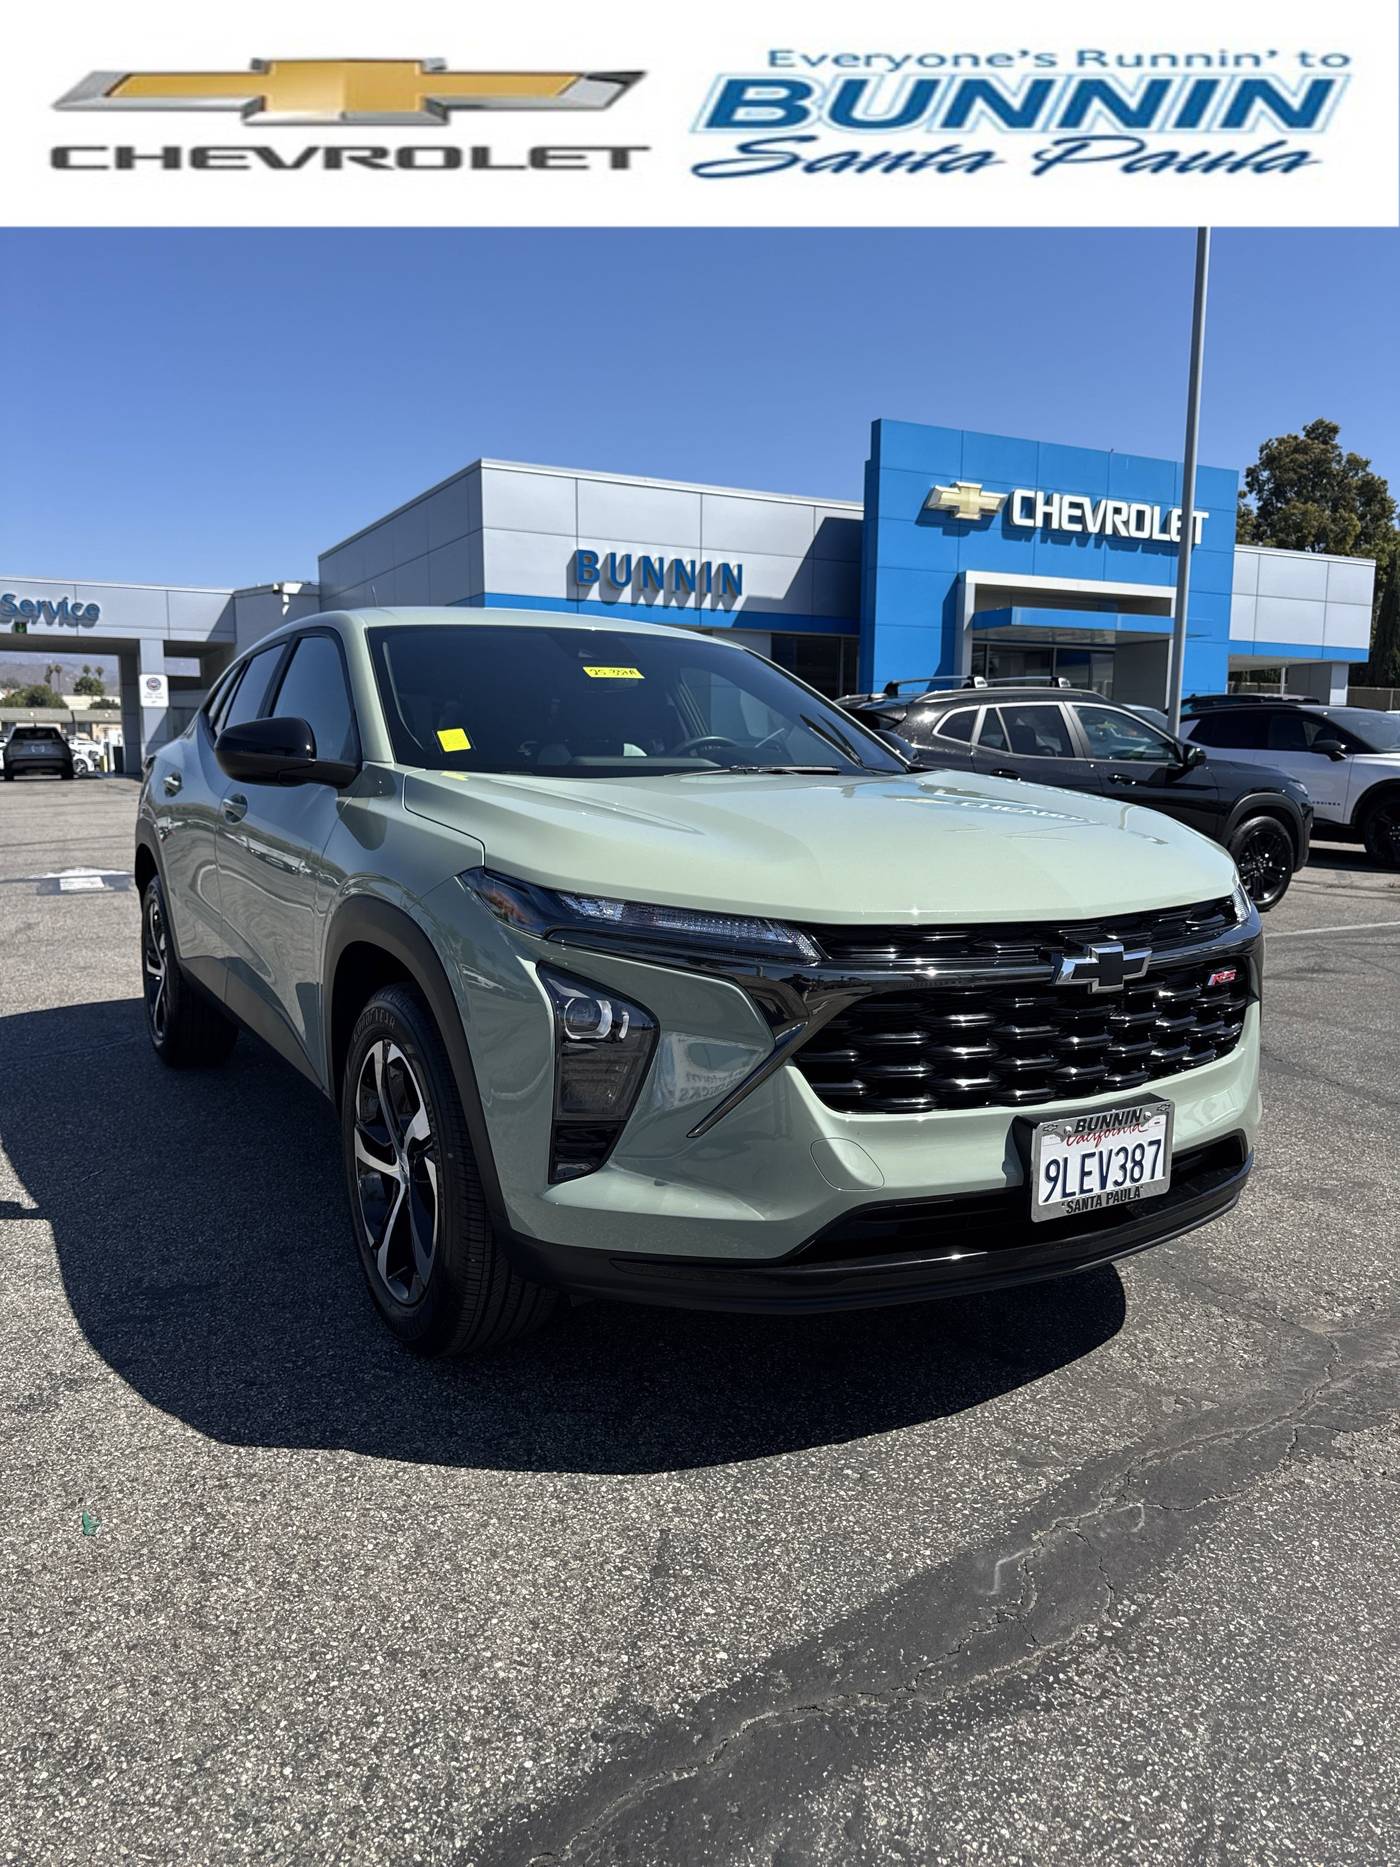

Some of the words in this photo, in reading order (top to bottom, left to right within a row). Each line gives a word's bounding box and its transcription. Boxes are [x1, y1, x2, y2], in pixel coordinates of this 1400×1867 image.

[576, 548, 743, 597] BUNNIN
[1, 592, 100, 618] Service
[1074, 1107, 1143, 1134] BUNNIN
[1043, 1138, 1162, 1203] 9LEV387
